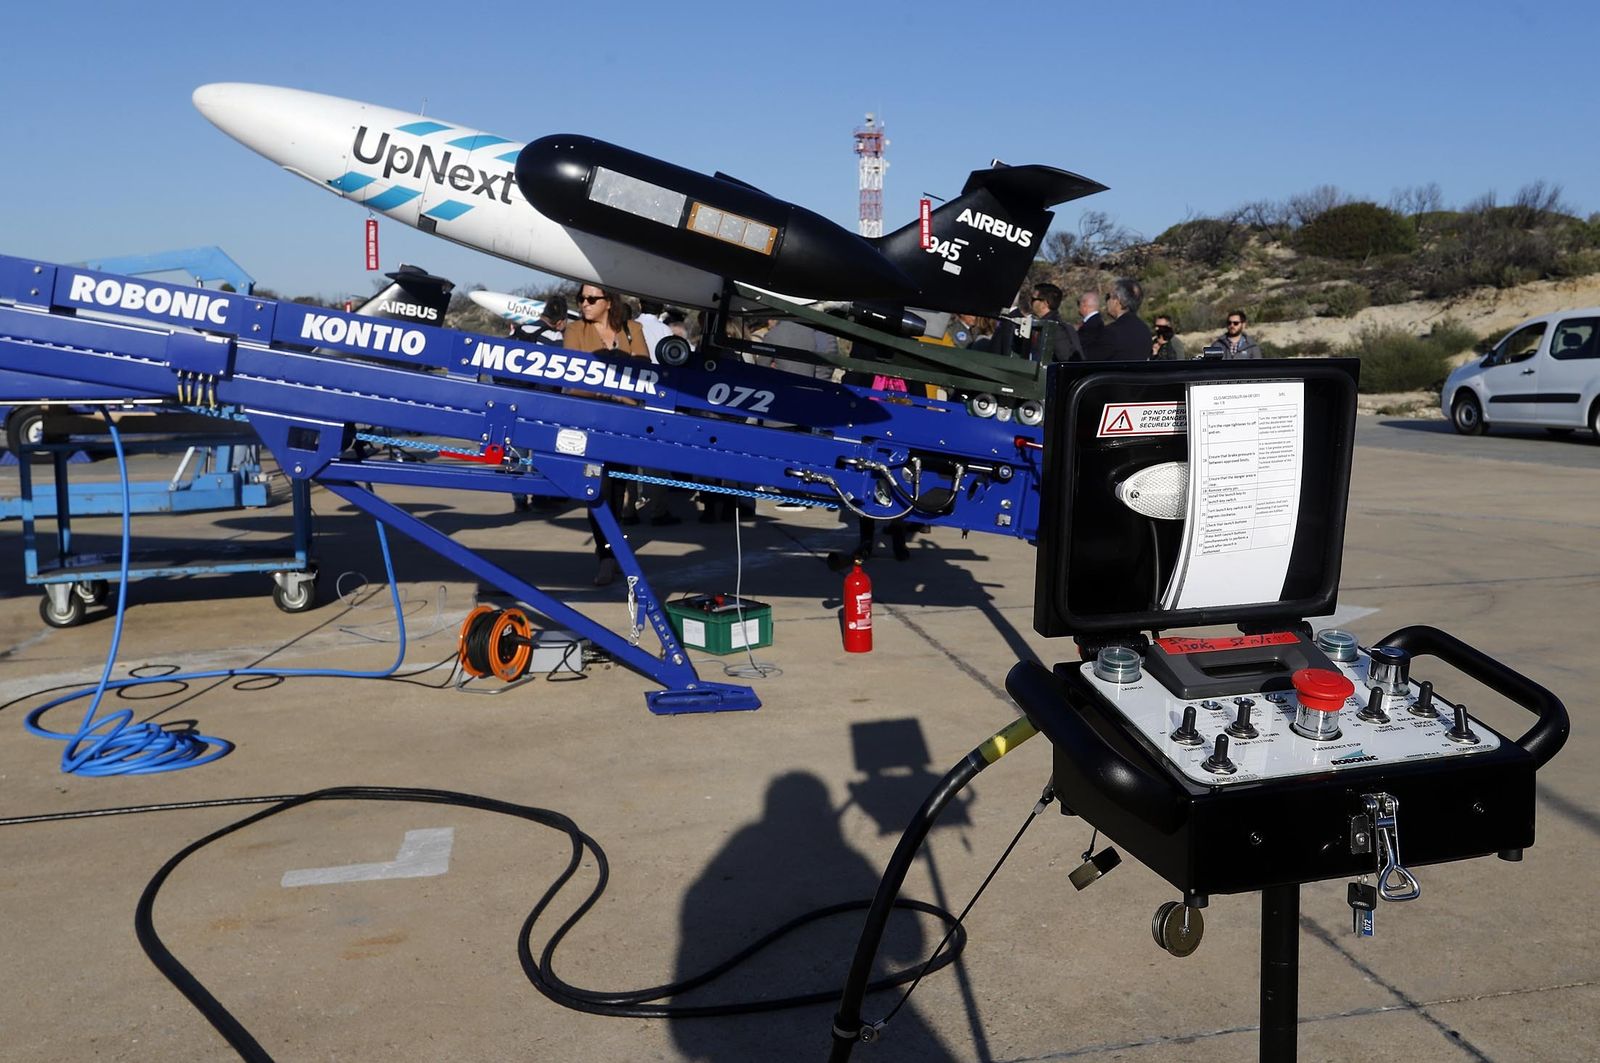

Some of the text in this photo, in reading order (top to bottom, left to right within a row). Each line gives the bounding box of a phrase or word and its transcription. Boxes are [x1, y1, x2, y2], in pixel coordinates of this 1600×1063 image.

[353, 126, 517, 205] UpNext
[956, 208, 1033, 248] AIRBUS
[926, 236, 962, 261] 945
[69, 274, 229, 324] ROBONIC
[378, 300, 438, 320] AIRBUS
[301, 313, 426, 356] KONTIO
[470, 342, 659, 395] MC2555LLR
[707, 383, 775, 413] 072
[1331, 755, 1378, 766] ROBONIC
